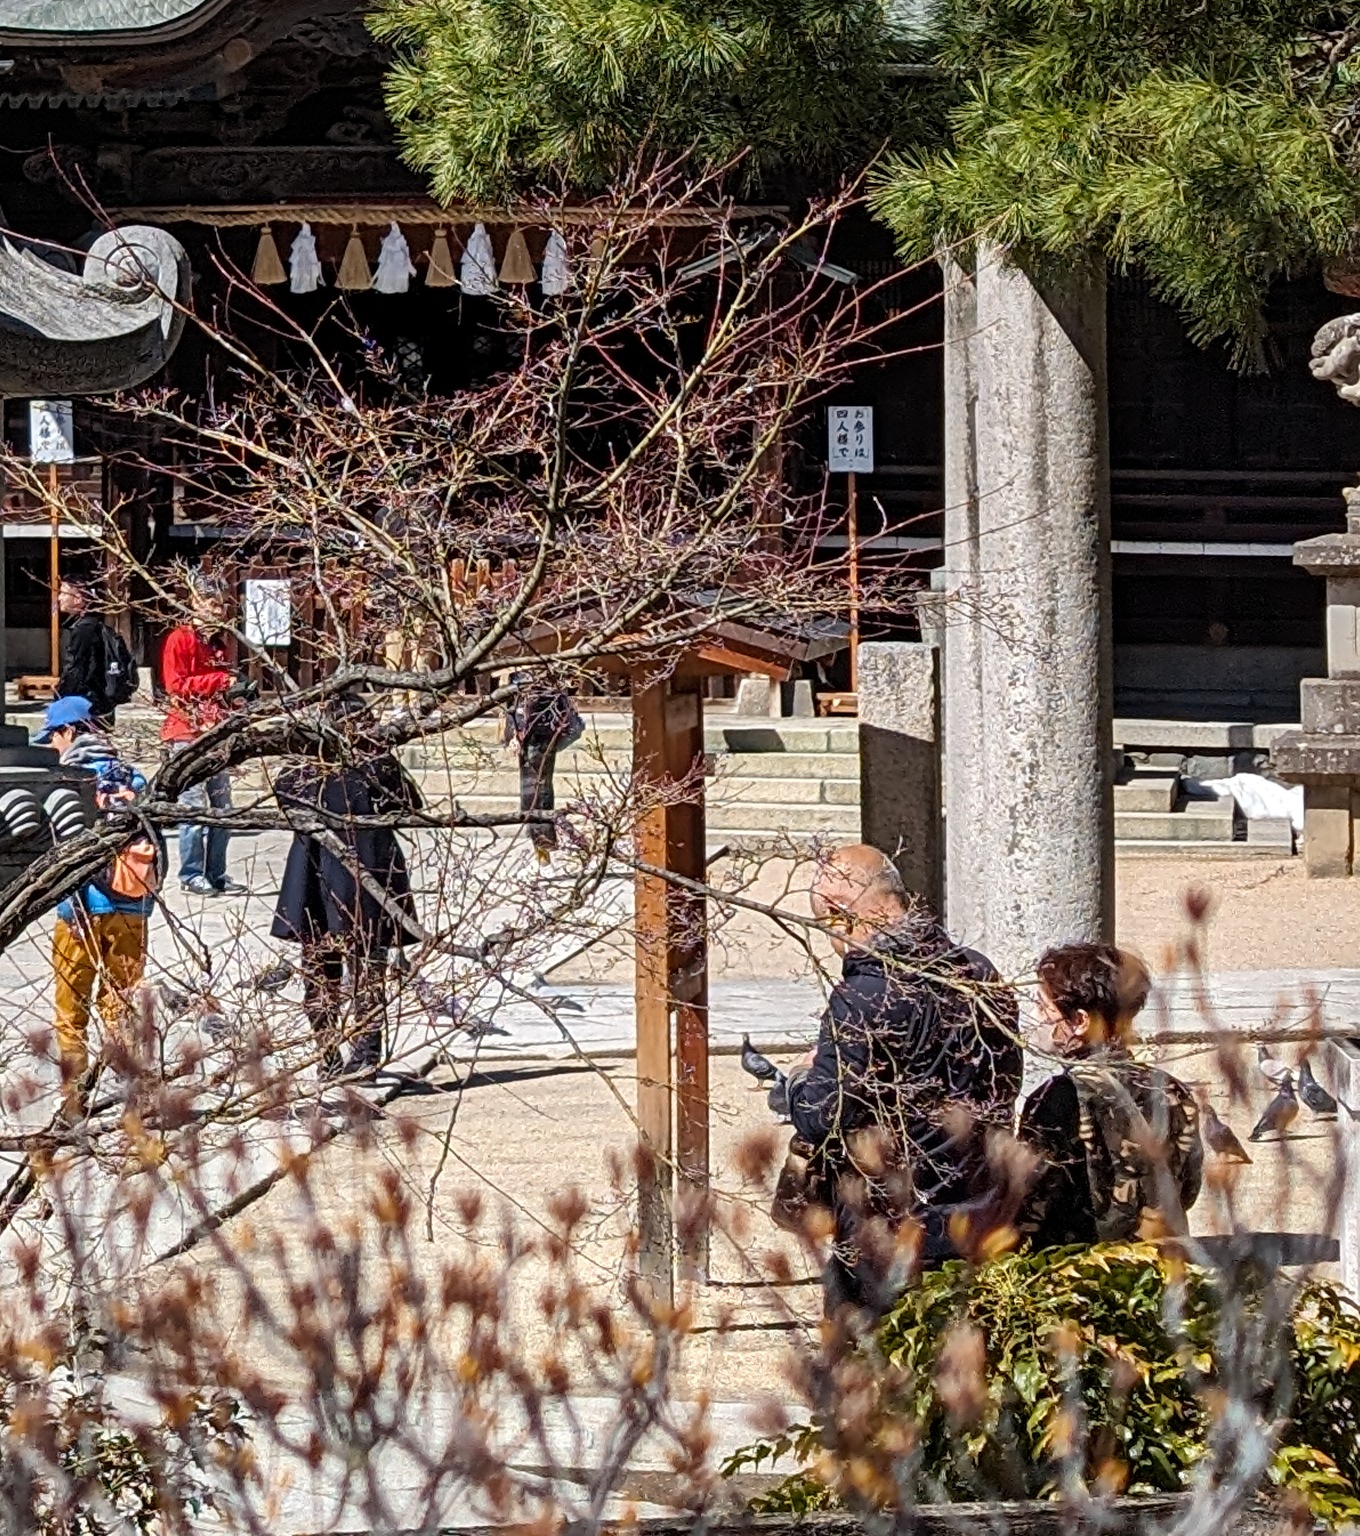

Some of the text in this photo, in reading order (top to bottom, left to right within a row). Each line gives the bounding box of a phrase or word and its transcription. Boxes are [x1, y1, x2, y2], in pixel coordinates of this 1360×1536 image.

[836, 409, 849, 458] 四人様で
[854, 409, 865, 458] お参りは
